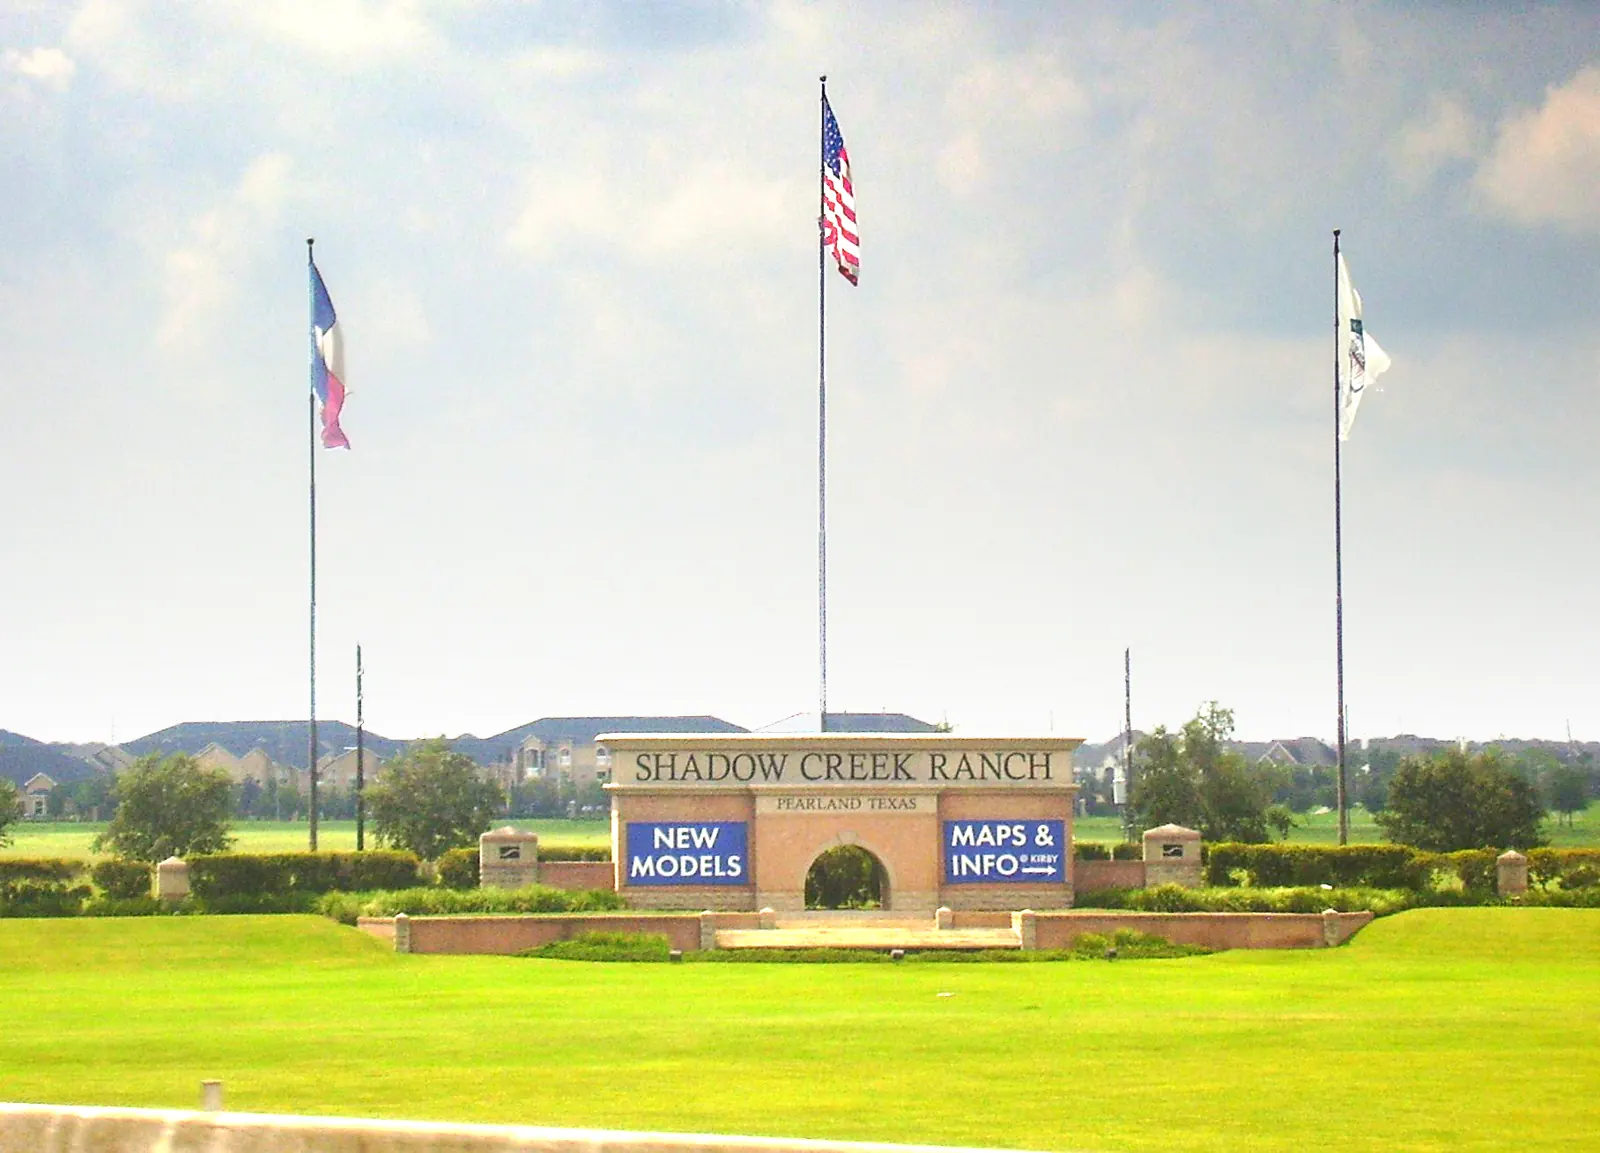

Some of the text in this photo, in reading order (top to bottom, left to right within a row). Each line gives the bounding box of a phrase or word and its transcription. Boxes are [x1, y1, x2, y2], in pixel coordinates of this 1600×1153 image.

[636, 752, 1053, 782] SHADOW CREEK RANCH
[777, 797, 917, 810] PEARLAND TEXAS
[653, 827, 720, 849] NEW
[951, 824, 1055, 847] MAPS &
[630, 855, 742, 878] MODELS
[952, 854, 1019, 877] INFO
[1030, 854, 1059, 863] KIRBY
